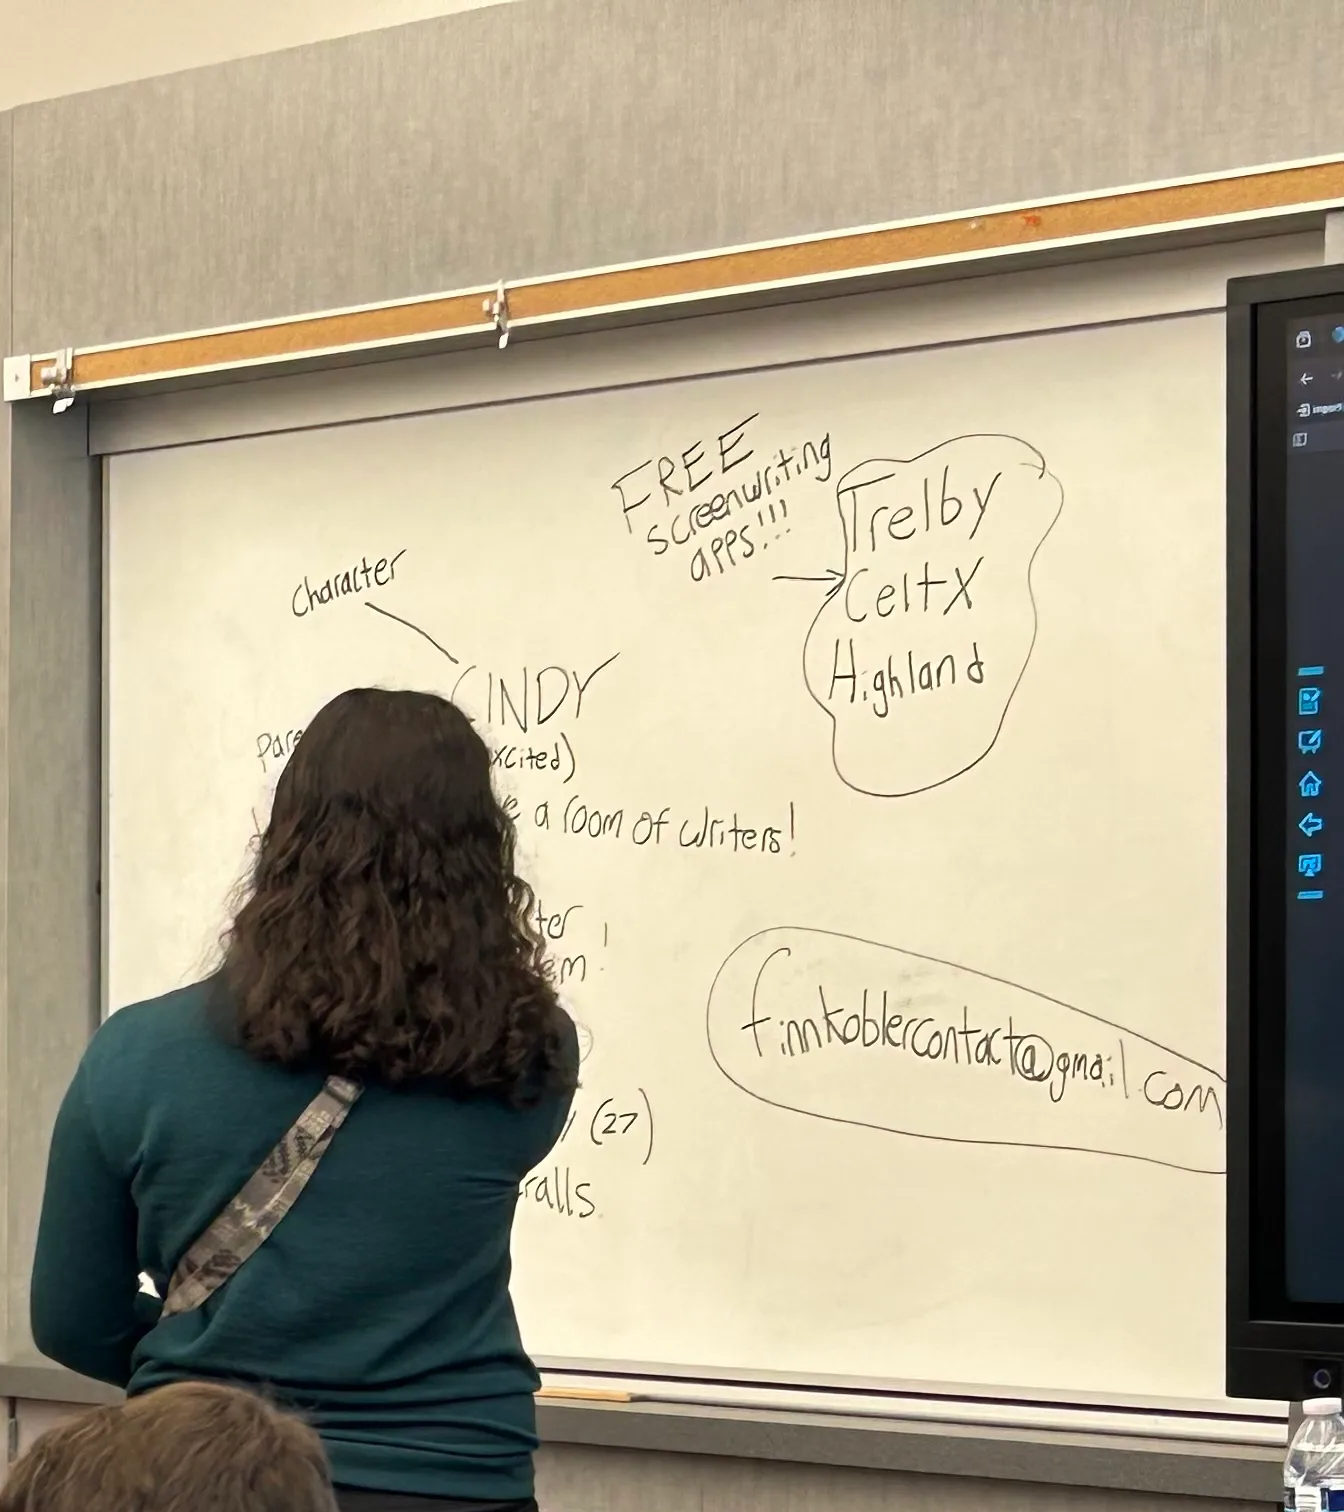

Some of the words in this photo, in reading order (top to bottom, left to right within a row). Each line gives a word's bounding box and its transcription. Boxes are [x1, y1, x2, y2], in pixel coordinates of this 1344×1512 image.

[611, 412, 760, 533] FREE
[648, 433, 831, 555] screenwriting
[838, 466, 1001, 552] Trelby
[451, 652, 620, 733] CINDY
[829, 638, 985, 718] Highland
[491, 732, 576, 783] xcited)
[534, 801, 550, 830] a
[563, 795, 622, 838] room
[633, 806, 670, 845] of
[590, 1088, 654, 1165] (27)
